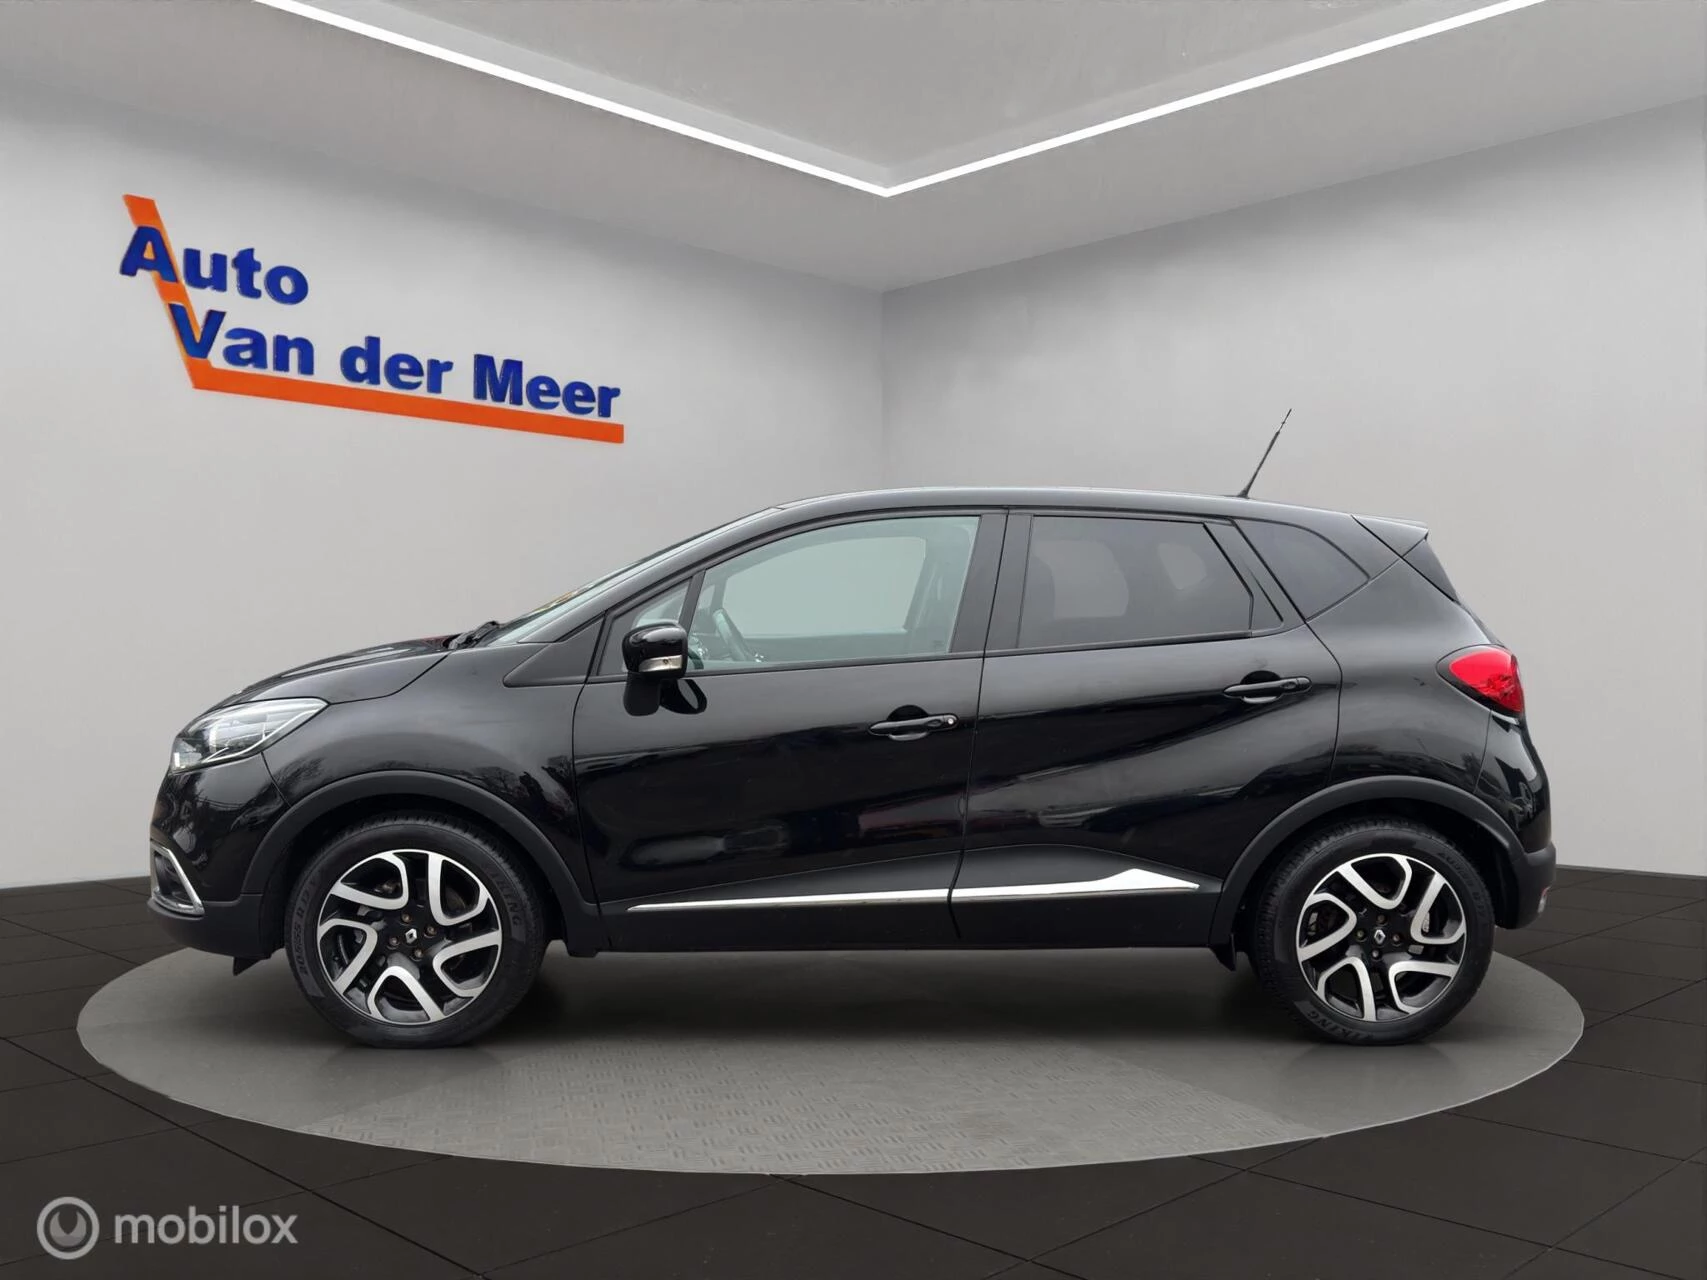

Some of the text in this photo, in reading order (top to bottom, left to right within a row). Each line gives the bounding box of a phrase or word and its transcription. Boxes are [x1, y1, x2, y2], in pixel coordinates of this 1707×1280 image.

[119, 225, 309, 305] Auto
[168, 303, 621, 418] Van der Meer
